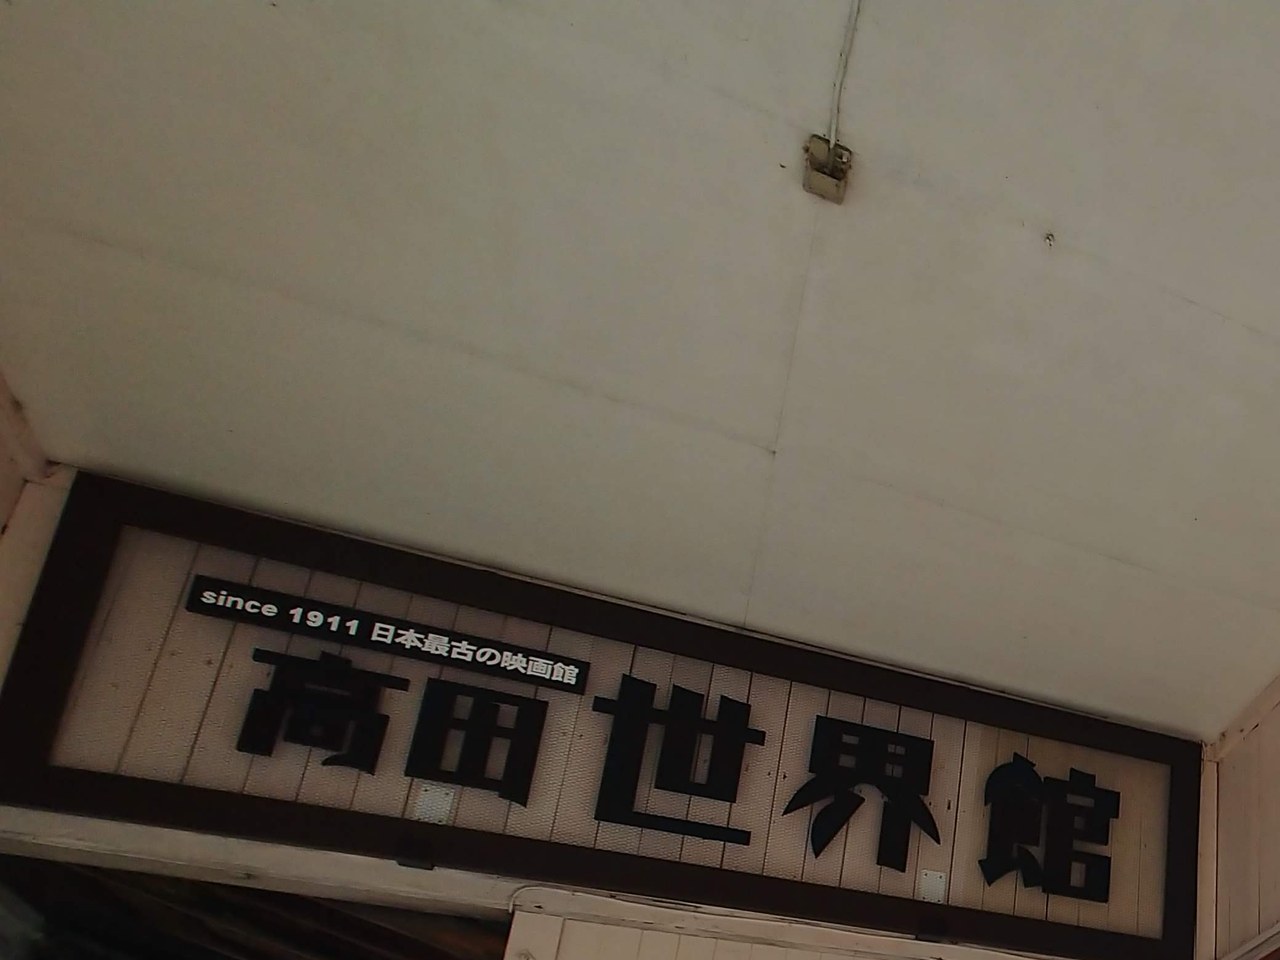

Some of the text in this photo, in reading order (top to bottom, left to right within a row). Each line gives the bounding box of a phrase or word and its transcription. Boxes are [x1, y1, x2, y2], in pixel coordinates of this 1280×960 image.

[200, 590, 580, 685] since 1911 日本最古の映画館
[235, 647, 1121, 903] 高田世界館
